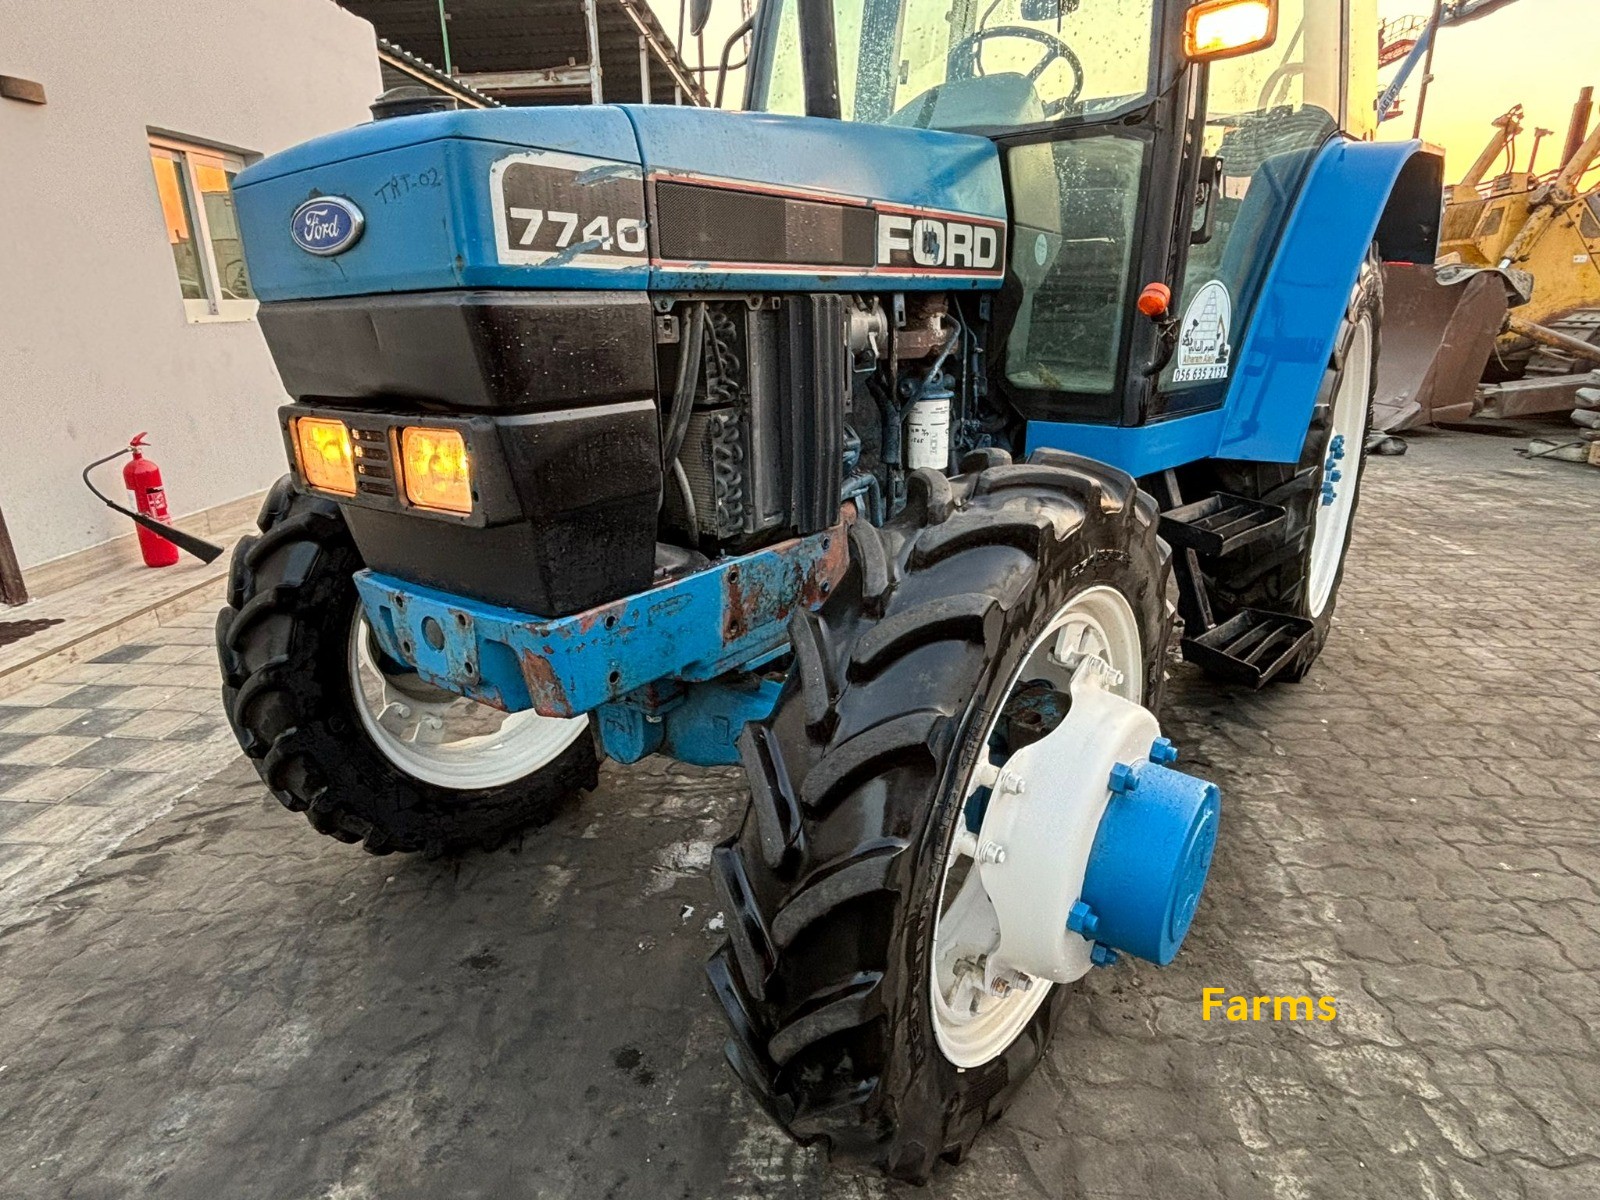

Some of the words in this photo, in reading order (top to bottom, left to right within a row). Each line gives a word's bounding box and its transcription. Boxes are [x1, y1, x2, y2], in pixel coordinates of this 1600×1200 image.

[304, 208, 340, 242] Ford
[509, 207, 646, 252] 7740
[877, 214, 997, 269] FORD
[1175, 368, 1190, 381] 056
[1192, 367, 1207, 380] 635
